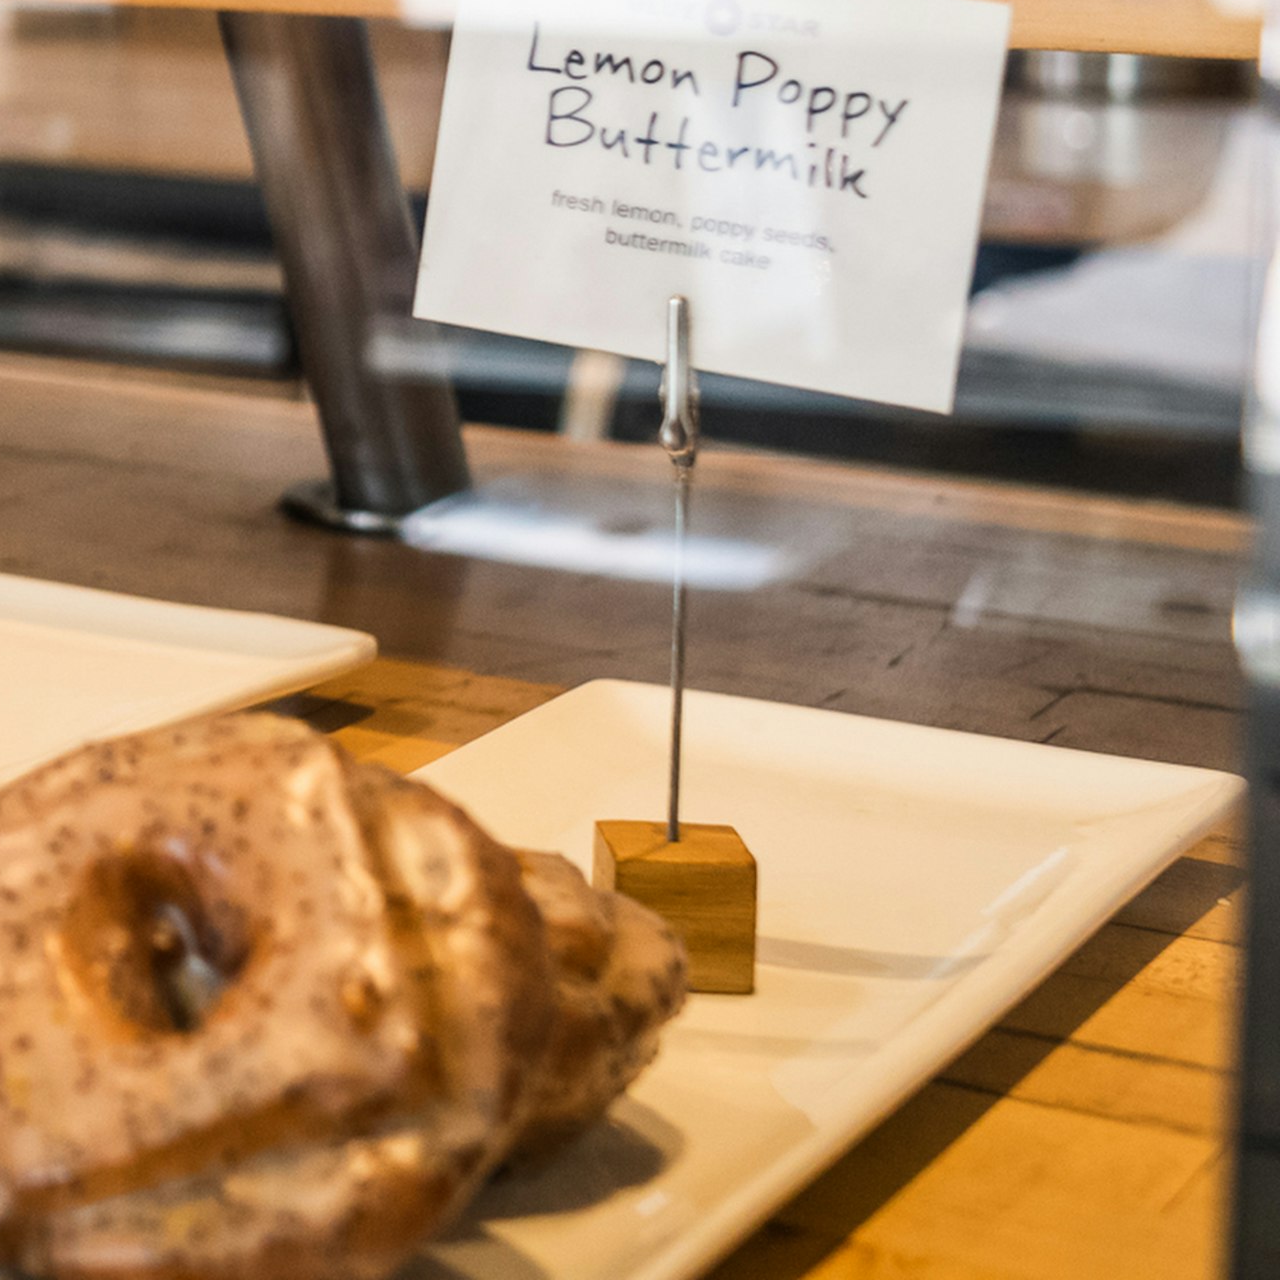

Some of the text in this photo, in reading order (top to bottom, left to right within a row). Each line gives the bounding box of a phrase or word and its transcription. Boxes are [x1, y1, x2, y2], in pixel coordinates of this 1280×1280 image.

[528, 21, 910, 148] Lemon Poppy
[545, 86, 870, 199] Buttermilk
[551, 189, 836, 253] fresh lemon, poppy seeds,
[604, 227, 772, 271] buttermilk cake
